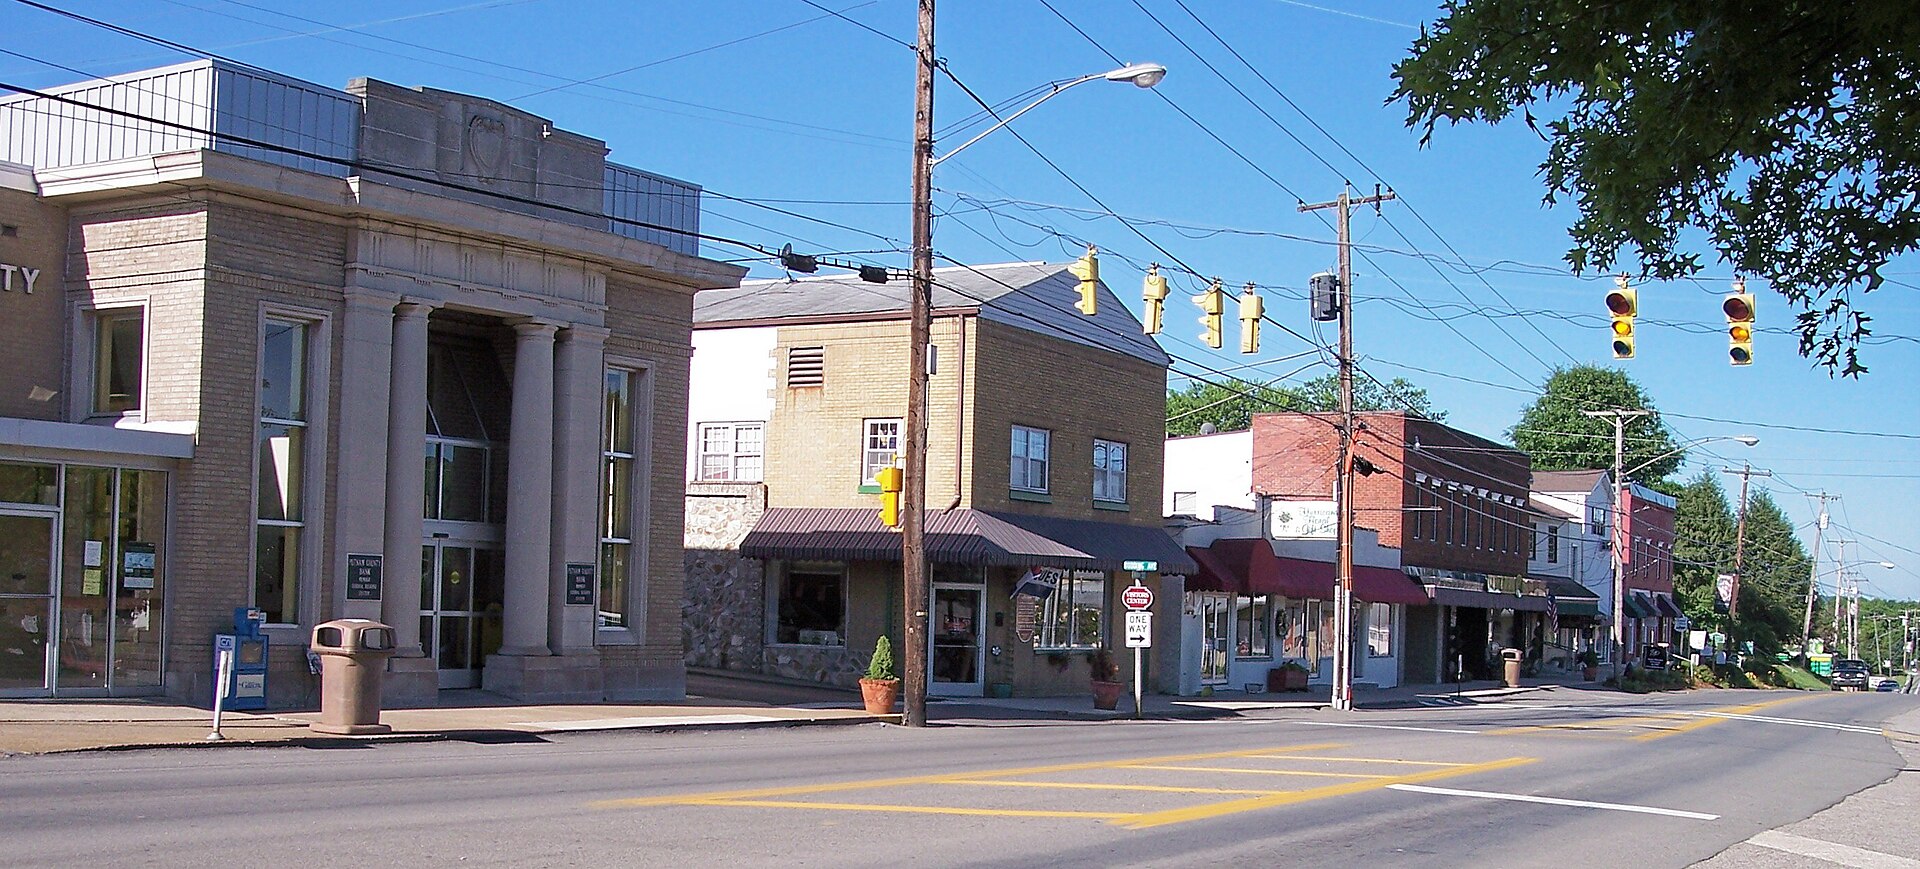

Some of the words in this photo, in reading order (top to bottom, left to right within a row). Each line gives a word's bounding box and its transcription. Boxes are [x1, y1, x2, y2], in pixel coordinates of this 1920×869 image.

[0, 263, 40, 294] TY
[1034, 569, 1059, 585] UES
[1129, 615, 1147, 623] ONE
[1129, 625, 1147, 633] WAY
